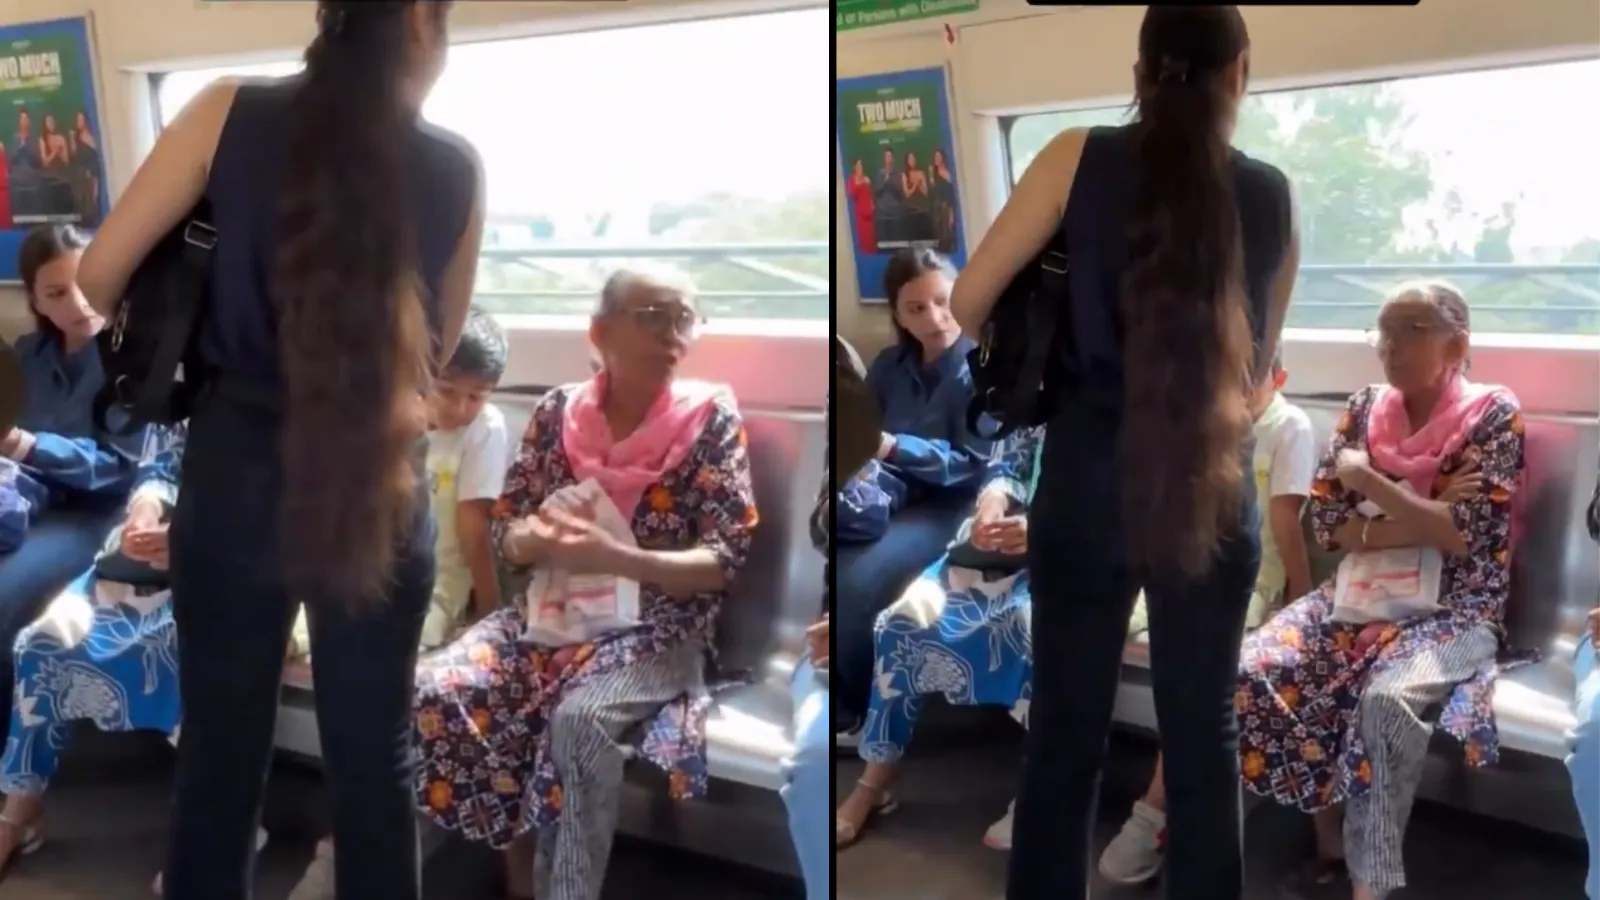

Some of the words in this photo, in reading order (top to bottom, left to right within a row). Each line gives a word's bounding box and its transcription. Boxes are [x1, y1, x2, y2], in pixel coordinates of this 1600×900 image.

[0, 57, 18, 79] WO
[19, 51, 61, 78] MUCH
[857, 102, 884, 123] TWO
[885, 98, 921, 119] MUCH
